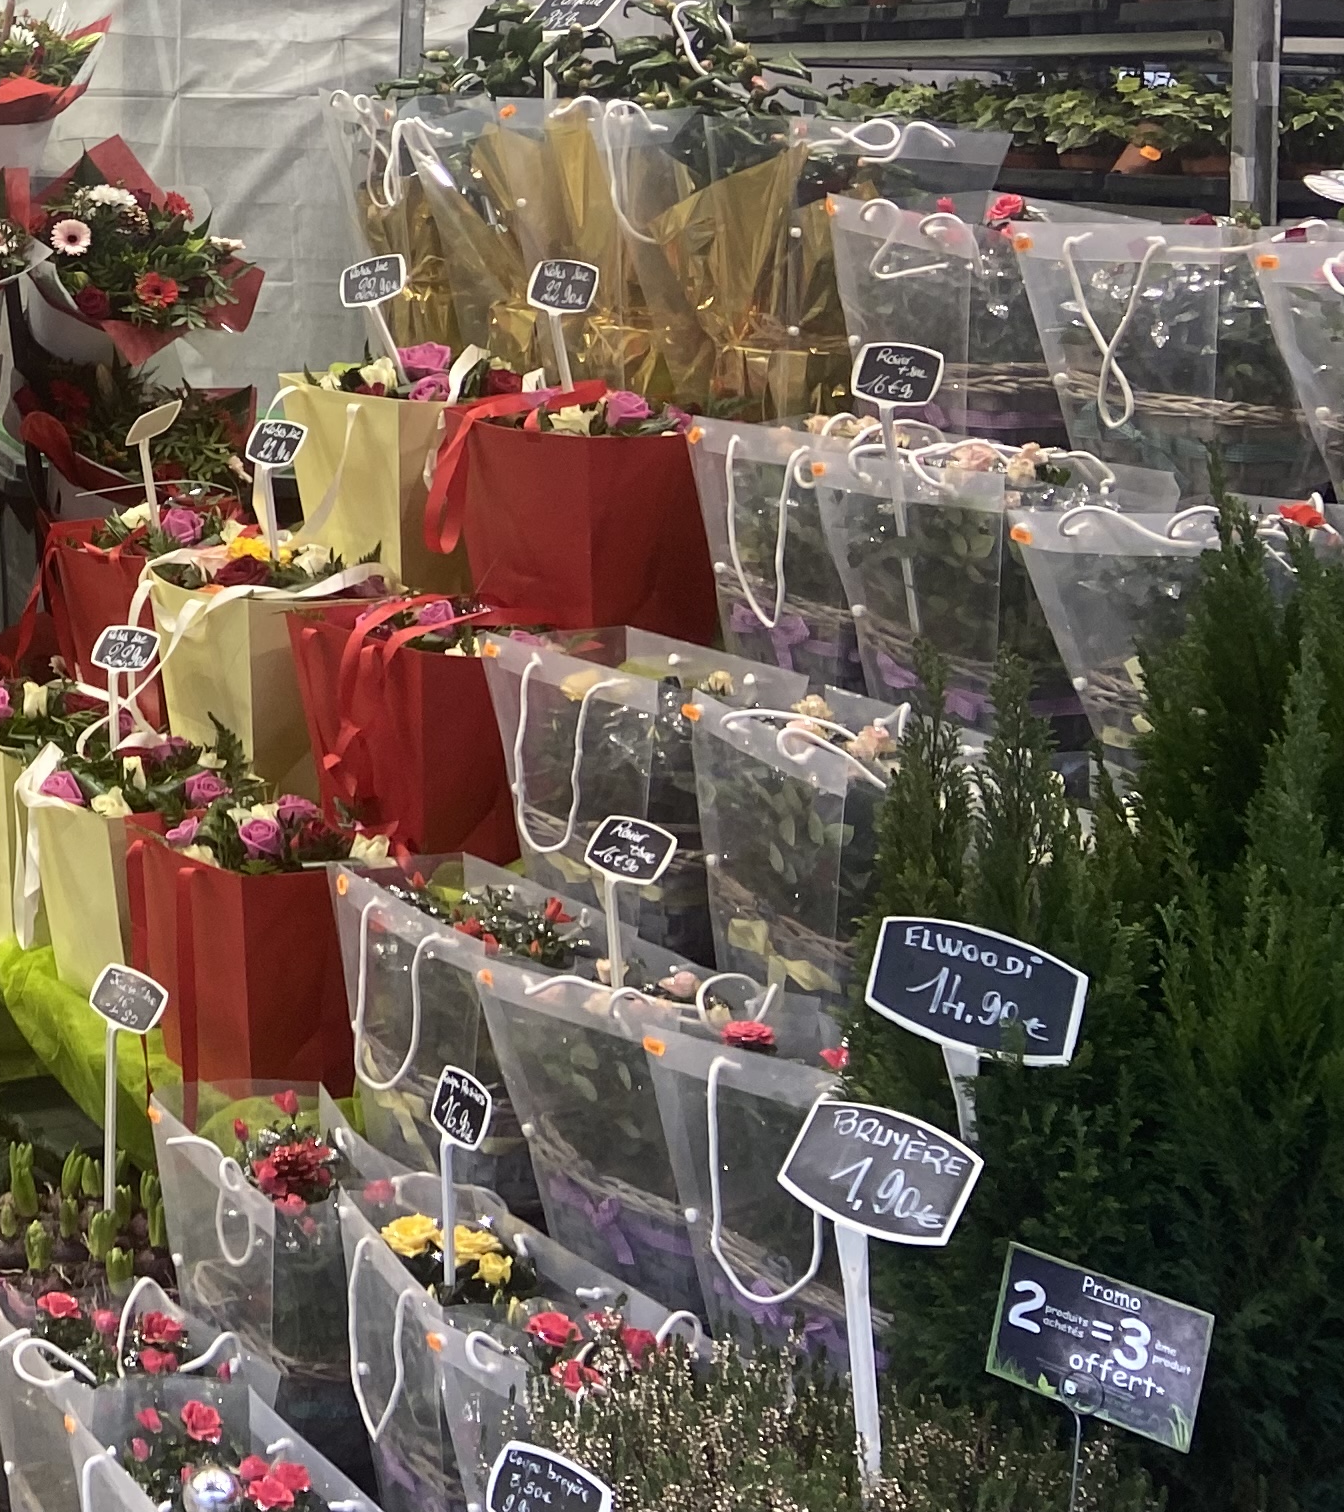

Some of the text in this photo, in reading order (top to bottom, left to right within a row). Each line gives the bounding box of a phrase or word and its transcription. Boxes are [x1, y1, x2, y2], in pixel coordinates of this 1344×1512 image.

[833, 1108, 968, 1177] BRUYÈRE
[1008, 1279, 1047, 1335] 2
[1044, 1304, 1090, 1328] produits
[1112, 1317, 1152, 1371] 3
[1081, 1275, 1142, 1311] Promo
[1041, 1316, 1192, 1376] achetés produit
